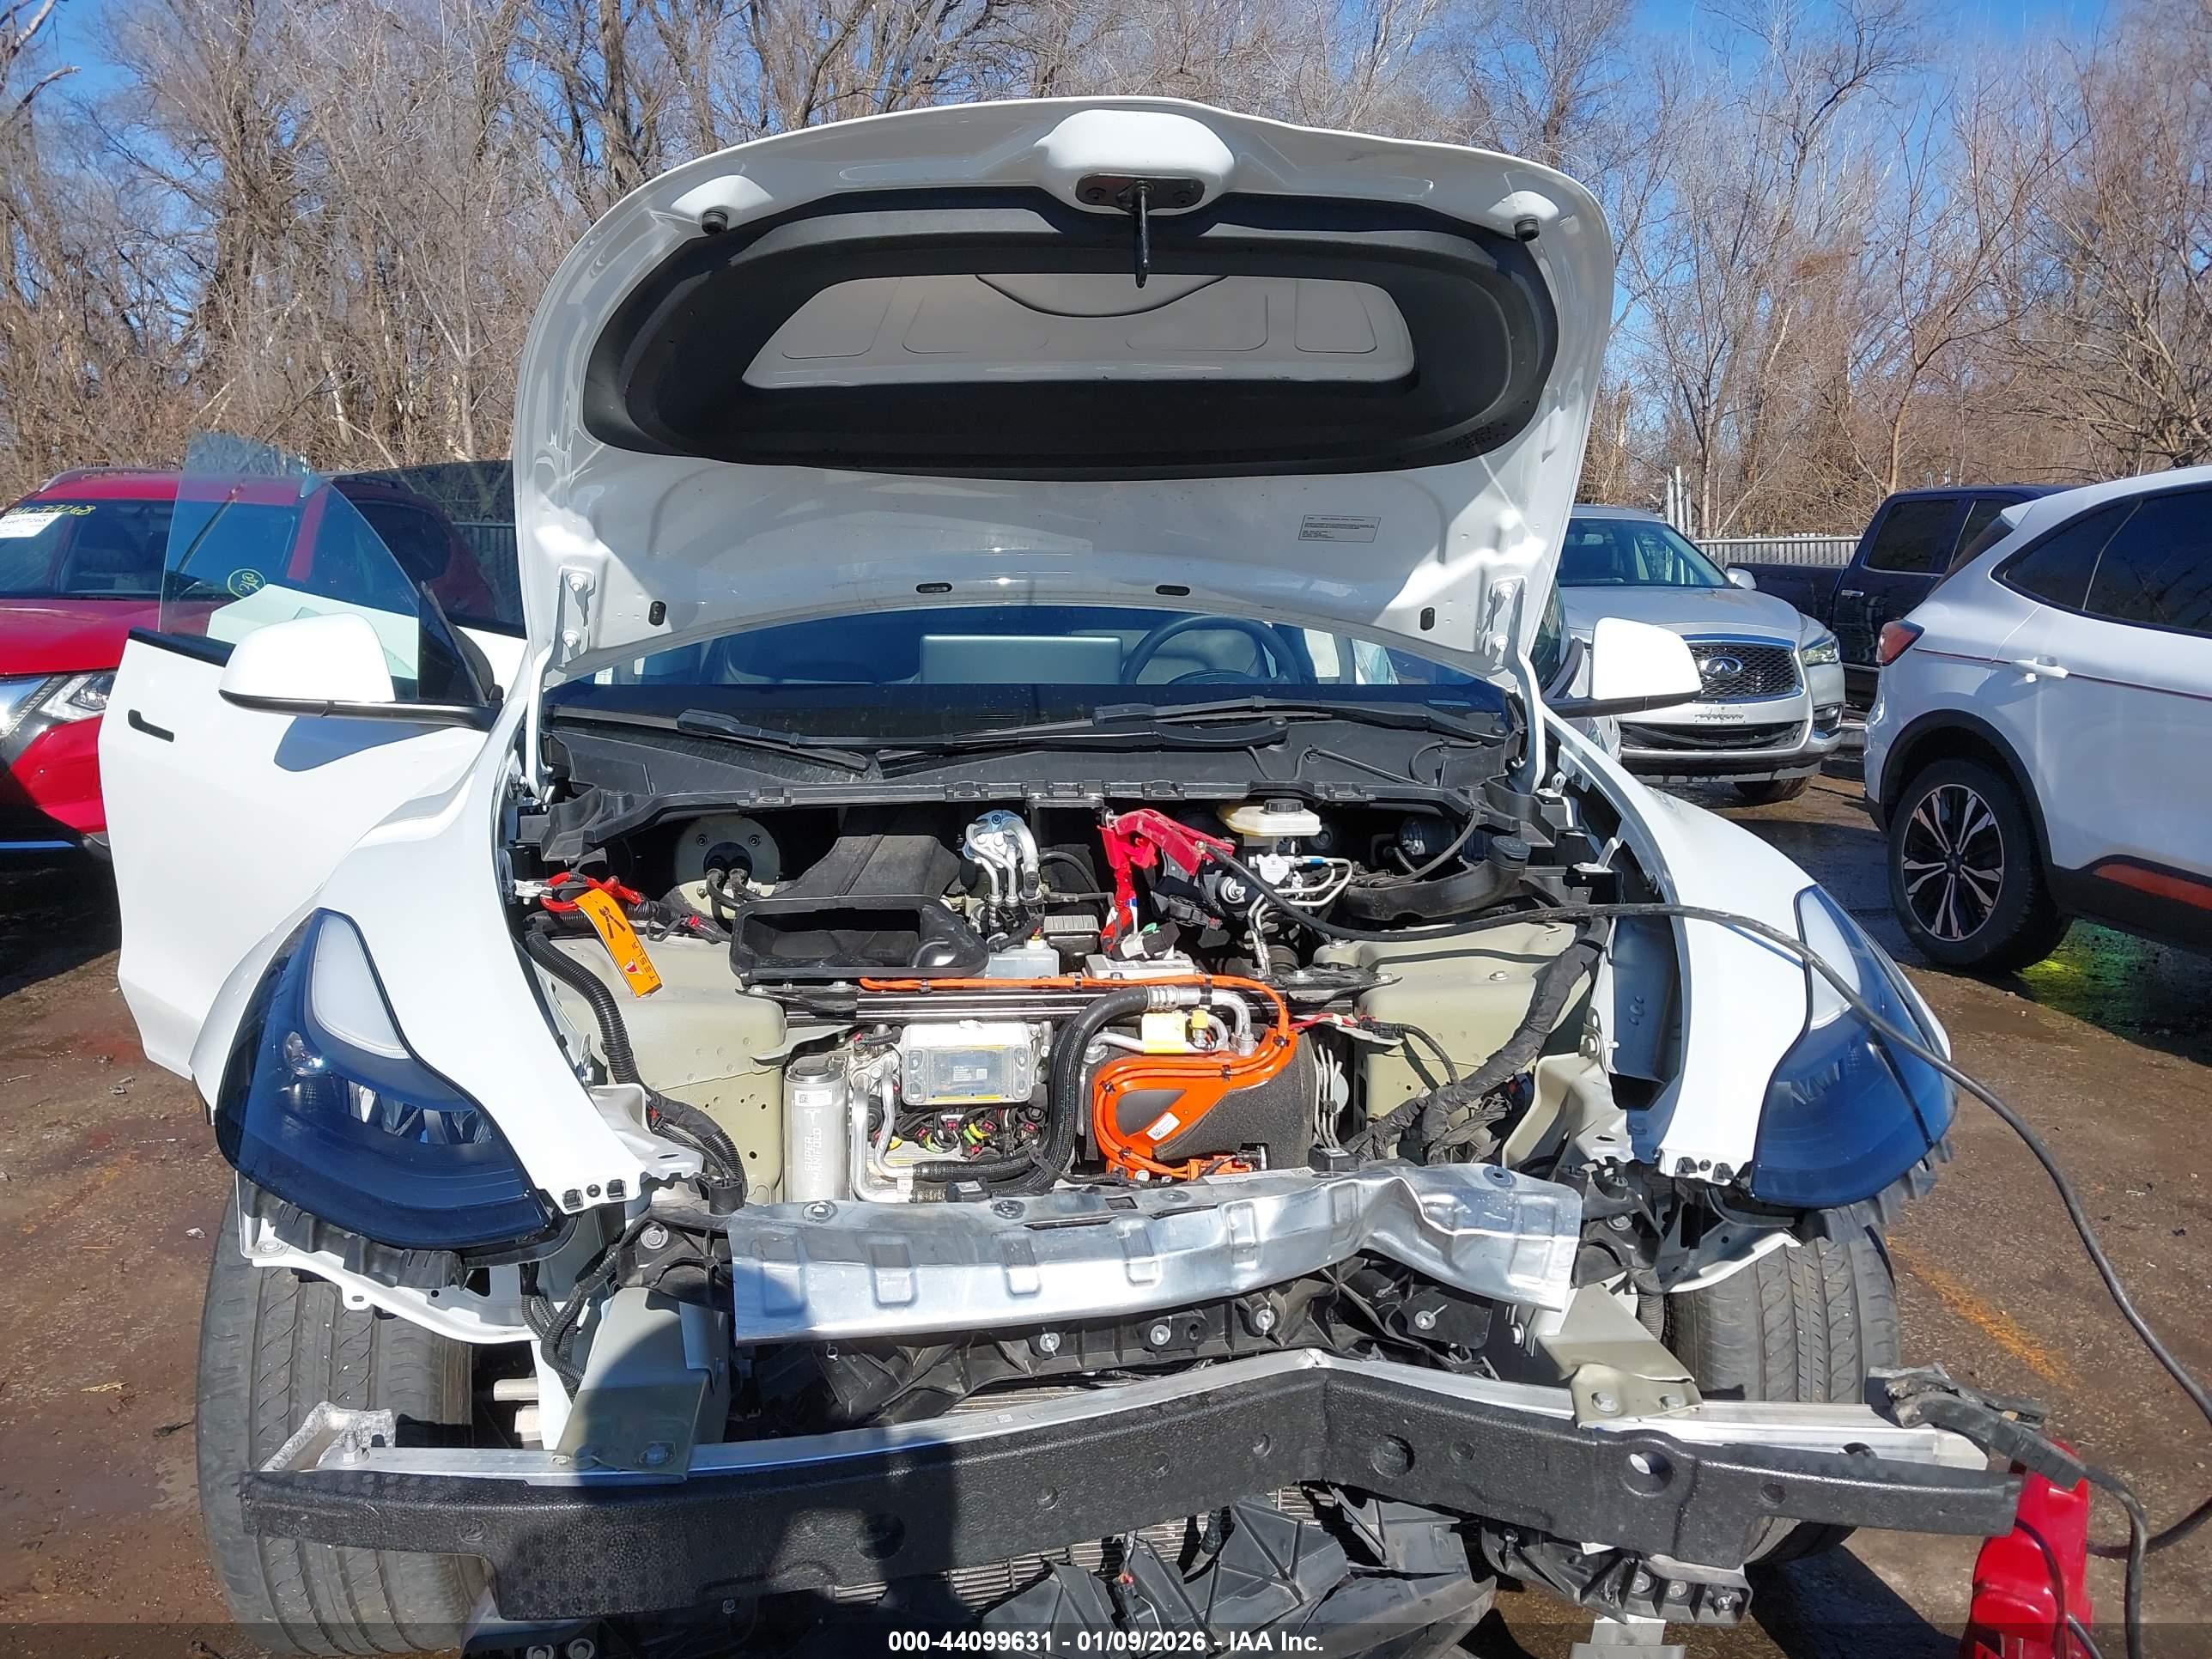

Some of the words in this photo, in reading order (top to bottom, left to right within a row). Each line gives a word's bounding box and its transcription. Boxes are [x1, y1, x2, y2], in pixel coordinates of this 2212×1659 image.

[631, 941, 656, 982] TESLA
[804, 1134, 814, 1172] SUPER
[811, 1127, 823, 1182] MANIFOLD
